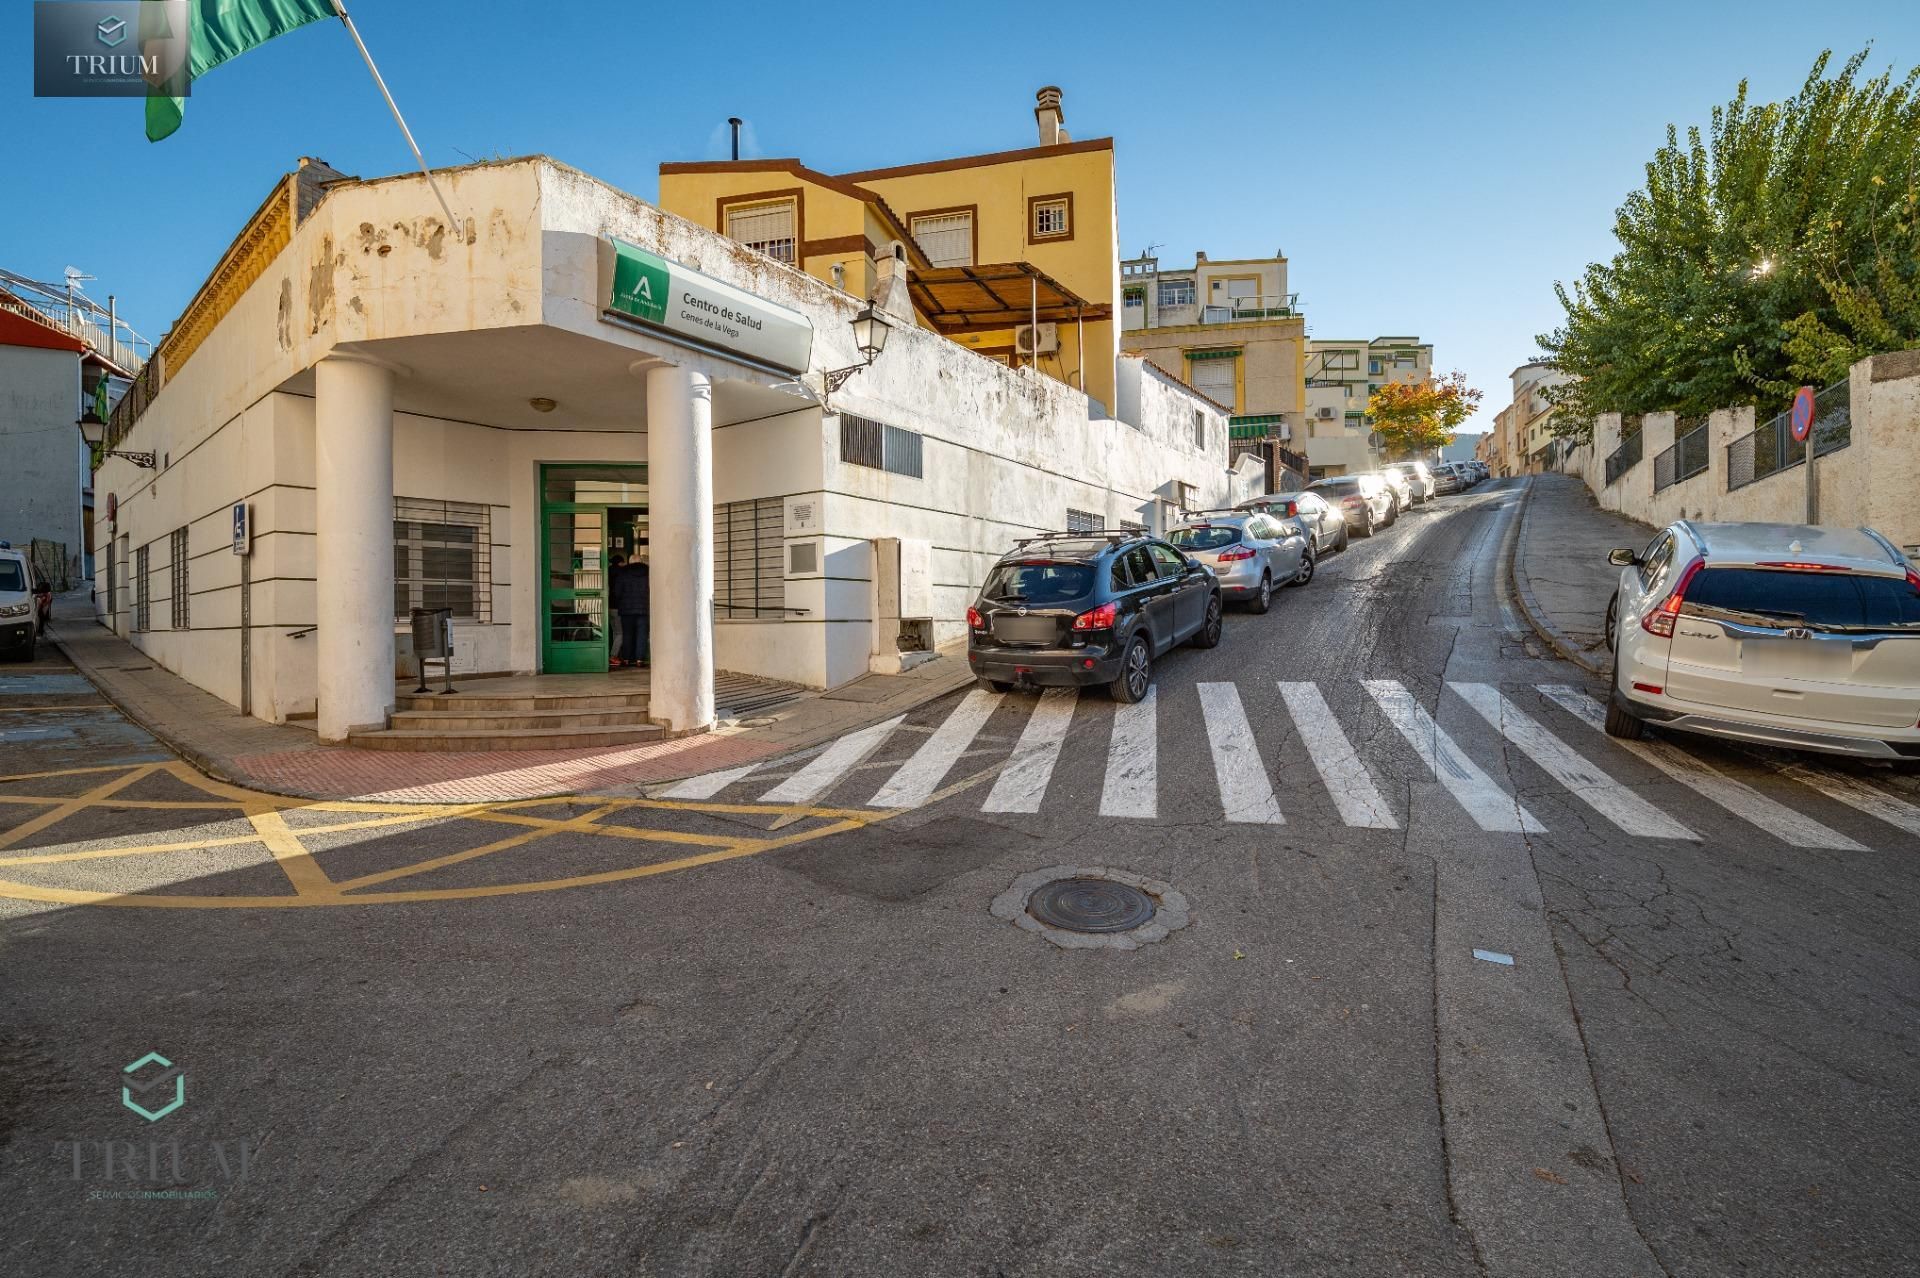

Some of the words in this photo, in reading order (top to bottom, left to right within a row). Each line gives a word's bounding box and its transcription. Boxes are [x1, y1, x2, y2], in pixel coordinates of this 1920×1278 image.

[681, 310, 703, 325] Cenes
[704, 318, 714, 329] de
[714, 321, 722, 332] la
[722, 325, 739, 338] Vega
[683, 293, 719, 314] Centro
[720, 304, 734, 320] de
[735, 311, 762, 331] Salud
